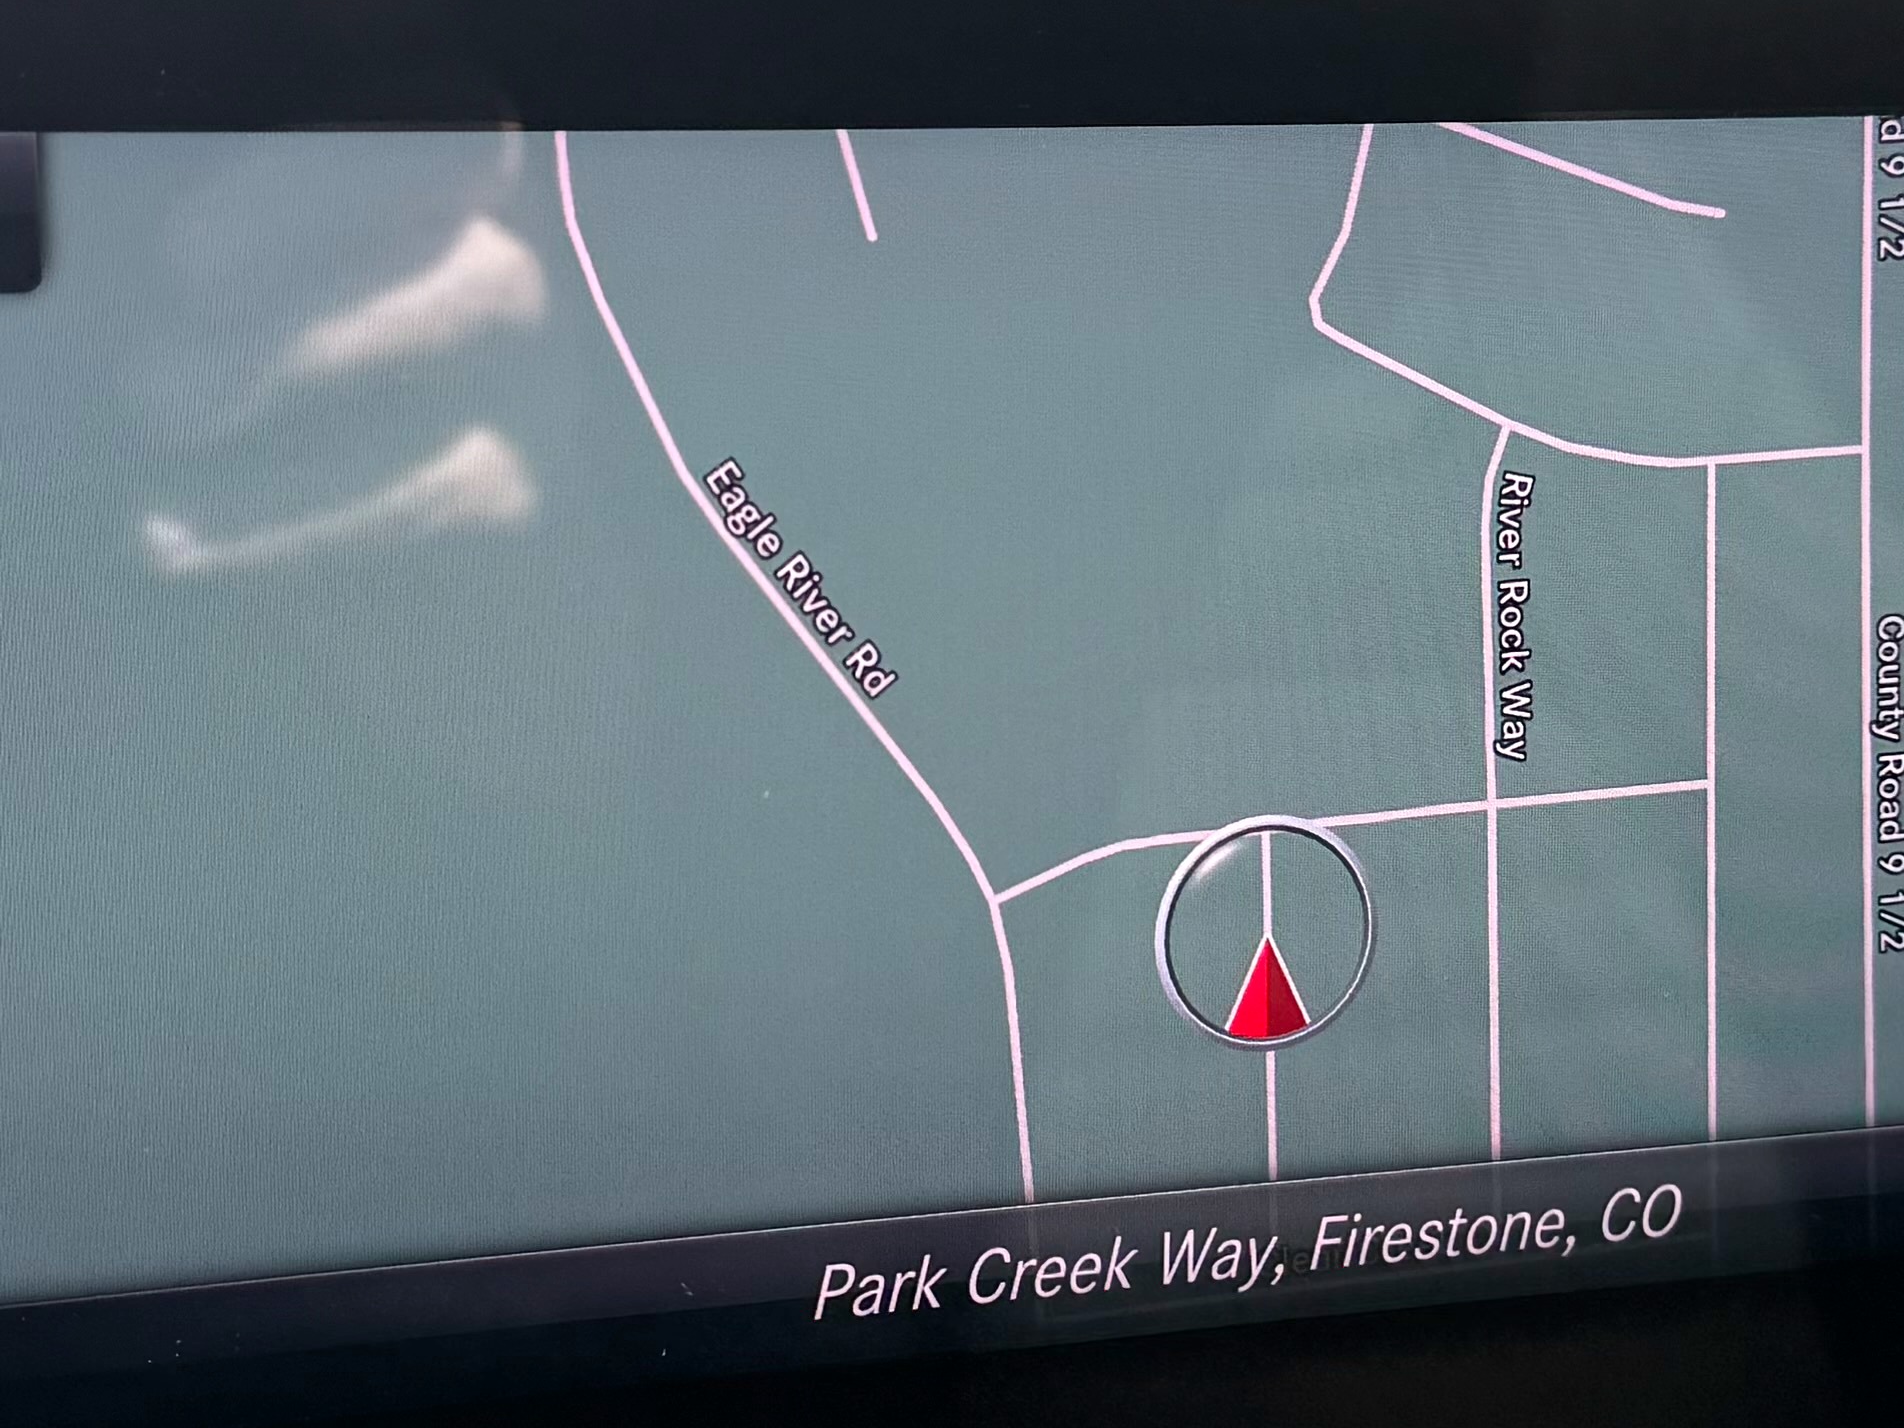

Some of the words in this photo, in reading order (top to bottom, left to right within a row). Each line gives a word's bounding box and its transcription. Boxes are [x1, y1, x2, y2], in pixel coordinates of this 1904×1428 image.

[1498, 471, 1534, 568] River
[705, 458, 782, 558] Eagle
[776, 552, 854, 644] River
[845, 641, 897, 697] Rd
[1498, 579, 1530, 673] Rock
[1495, 680, 1532, 760] Way
[813, 1254, 943, 1321] Park
[967, 1236, 1138, 1305] Creek
[1160, 1224, 1288, 1293] Way,
[1309, 1201, 1578, 1270] Firestone,
[1600, 1183, 1684, 1243] CO
